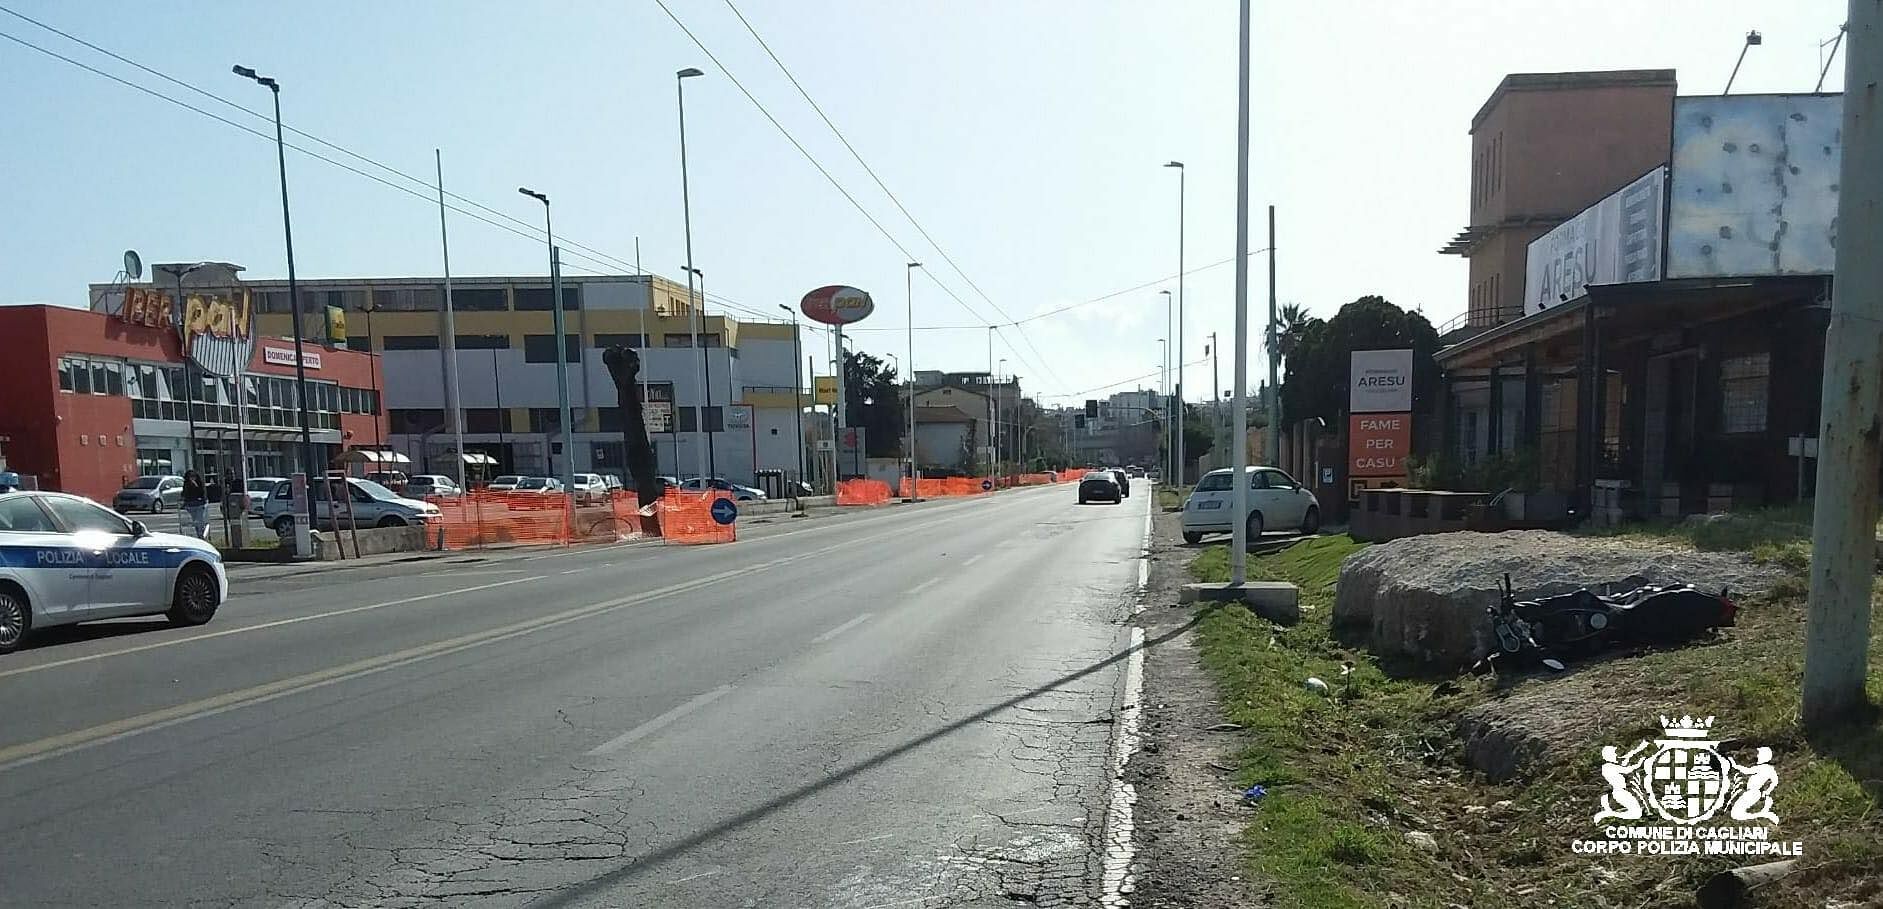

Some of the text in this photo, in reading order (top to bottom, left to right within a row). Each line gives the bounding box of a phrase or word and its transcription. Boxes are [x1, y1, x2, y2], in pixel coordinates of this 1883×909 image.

[1540, 240, 1597, 302] ARESU
[1358, 376, 1405, 387] ARESU
[1360, 419, 1401, 430] FAME
[1366, 439, 1394, 449] PER
[1356, 458, 1395, 468] CASU
[37, 550, 149, 564] POLIZIA LOCALE
